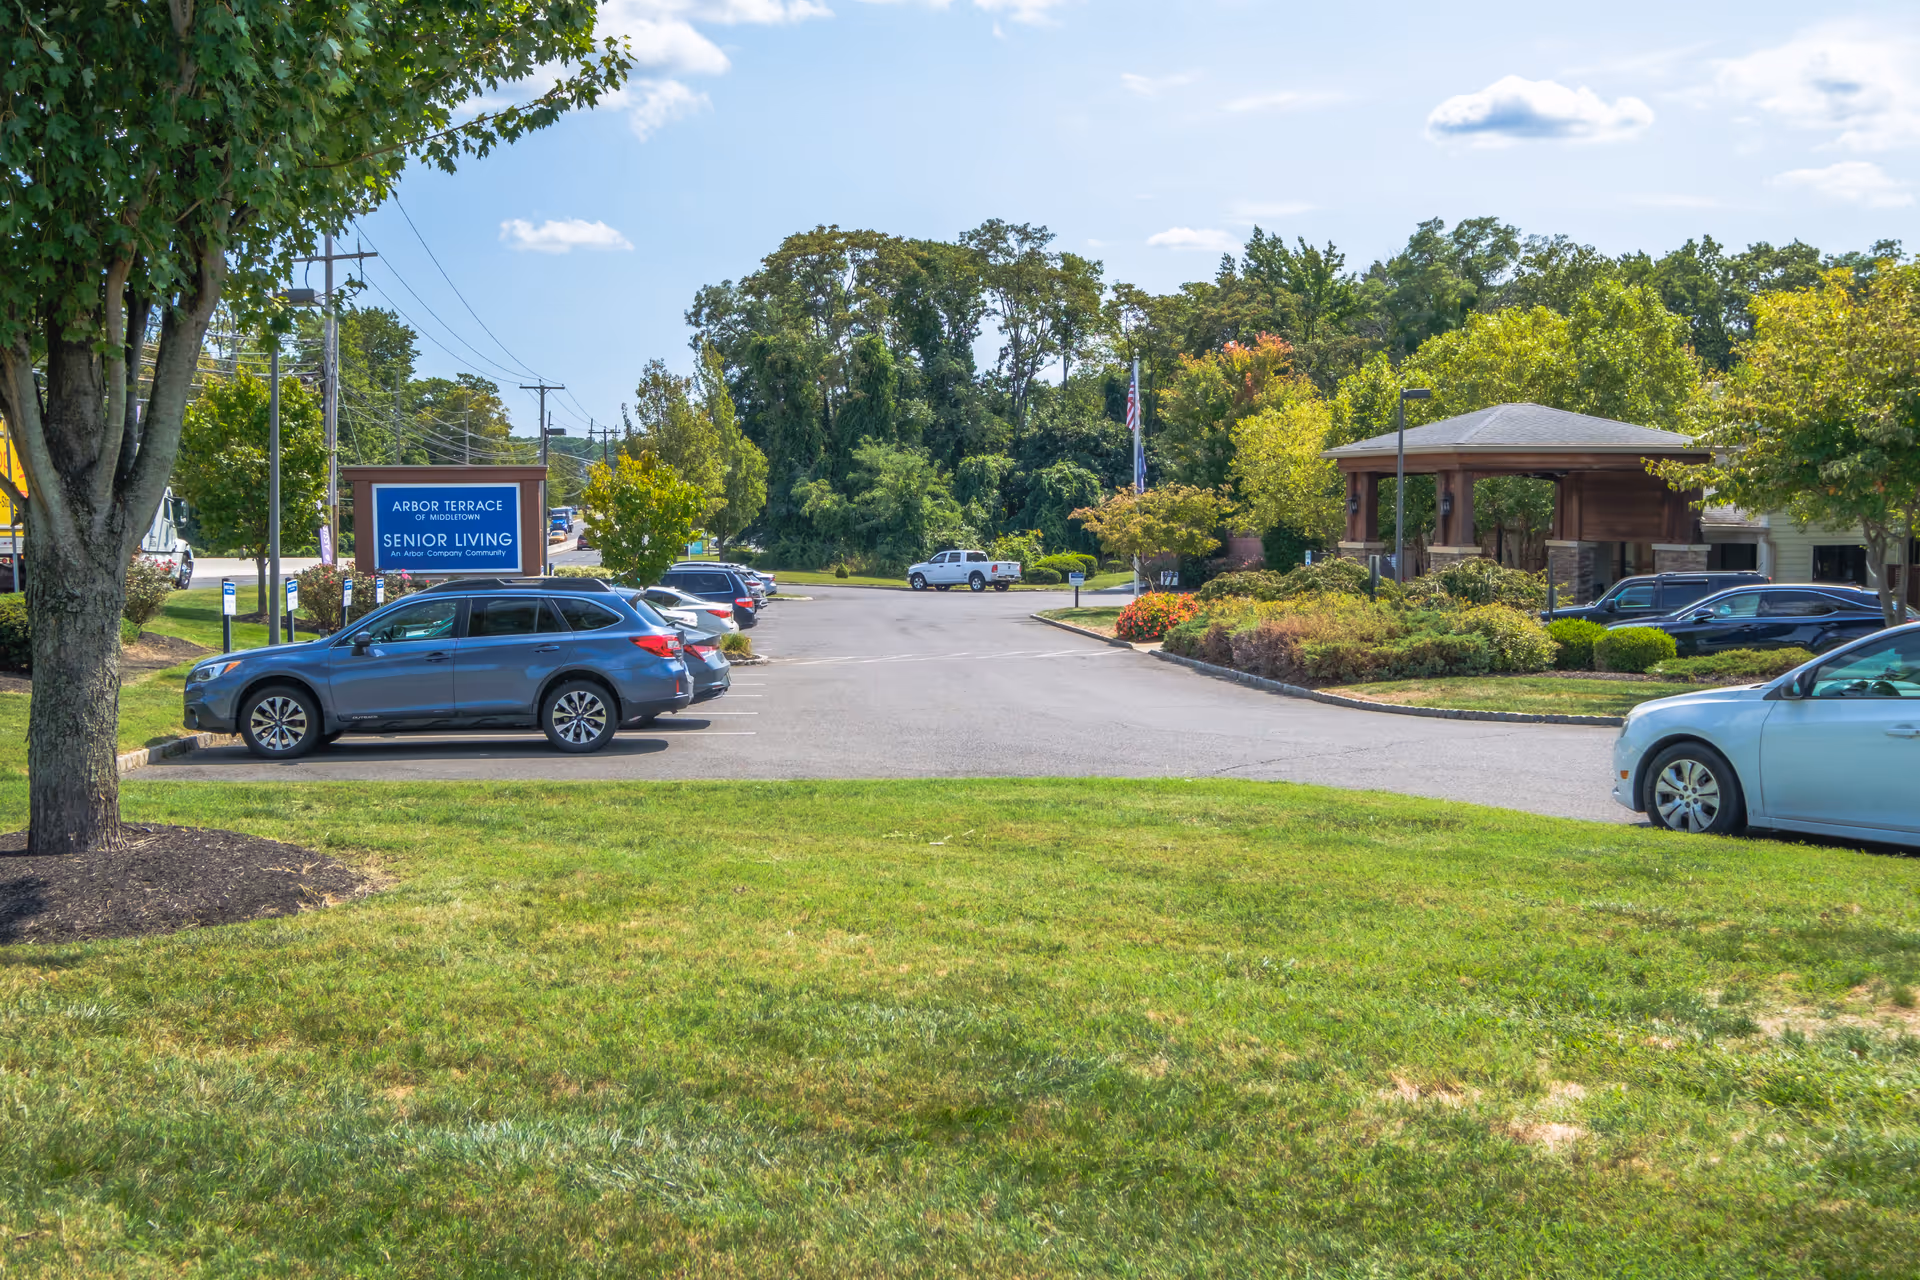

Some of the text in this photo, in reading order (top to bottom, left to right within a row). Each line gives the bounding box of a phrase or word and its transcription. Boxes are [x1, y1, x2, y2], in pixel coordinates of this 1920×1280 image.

[392, 500, 503, 512] ARBOR TERRACE
[415, 513, 480, 521] OF MIDDLETOWN
[383, 532, 513, 548] SENIOR LIVING
[427, 549, 462, 558] Company
[465, 549, 507, 558] Community
